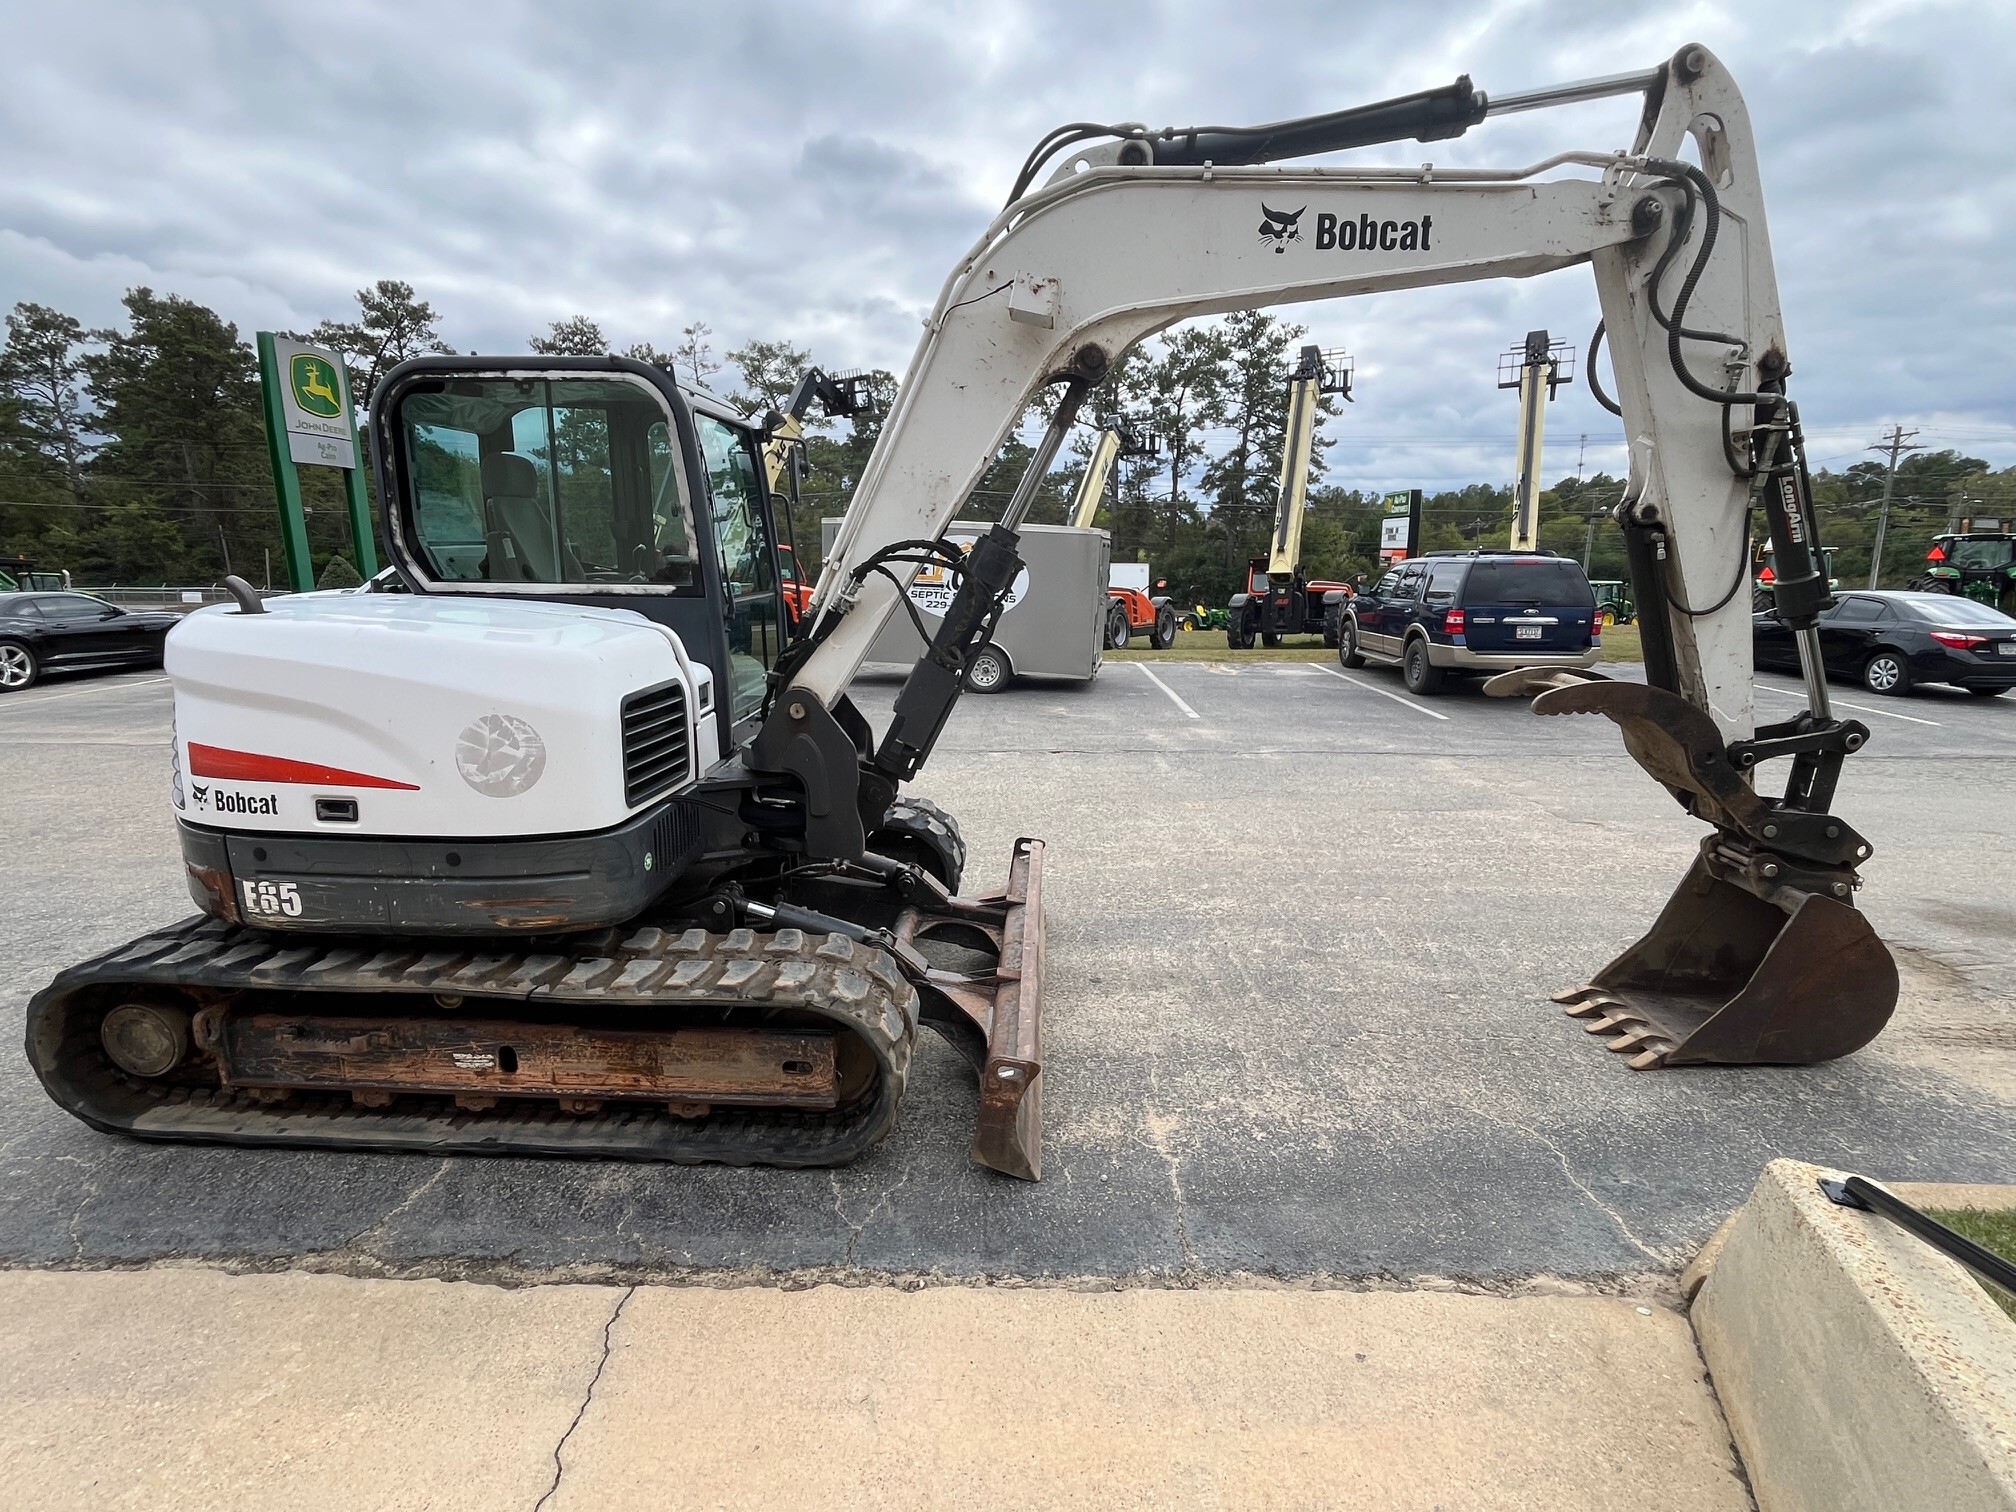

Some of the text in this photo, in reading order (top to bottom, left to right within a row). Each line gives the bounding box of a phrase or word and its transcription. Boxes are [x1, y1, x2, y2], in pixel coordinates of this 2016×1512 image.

[1316, 213, 1432, 251] Bobcat
[295, 420, 348, 436] JOHN DEERE
[1779, 475, 1804, 543] LongArm
[910, 590, 950, 600] SEPTIC
[214, 789, 278, 816] Bobcat
[242, 880, 303, 917] E85
